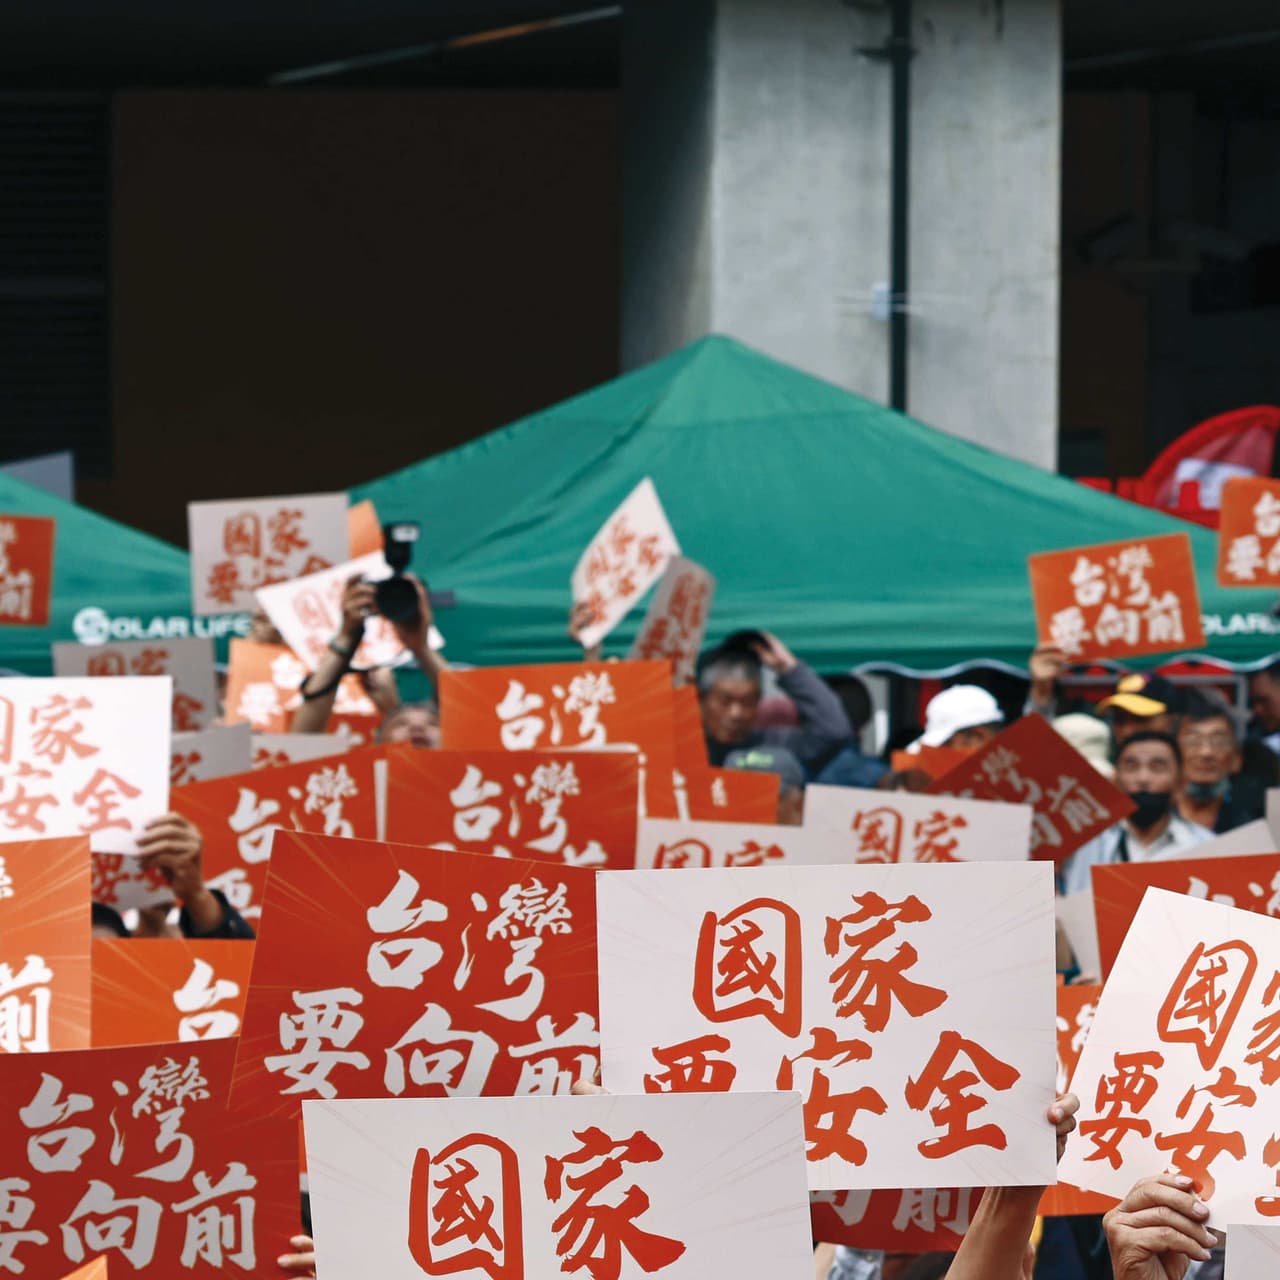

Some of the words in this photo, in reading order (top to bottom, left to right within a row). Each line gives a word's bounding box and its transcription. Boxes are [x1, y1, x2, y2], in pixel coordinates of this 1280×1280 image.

[223, 509, 309, 558] 國家
[1070, 544, 1152, 606] 台灣
[1050, 592, 1185, 656] 要向前
[496, 671, 616, 750] 台灣
[228, 764, 358, 864] 台灣
[450, 761, 580, 853] 台灣
[851, 806, 968, 863] 國家
[366, 869, 574, 1023] 台灣
[693, 891, 948, 1038] 國家
[18, 1055, 210, 1183] 台灣
[1079, 1051, 1280, 1217] 要安
